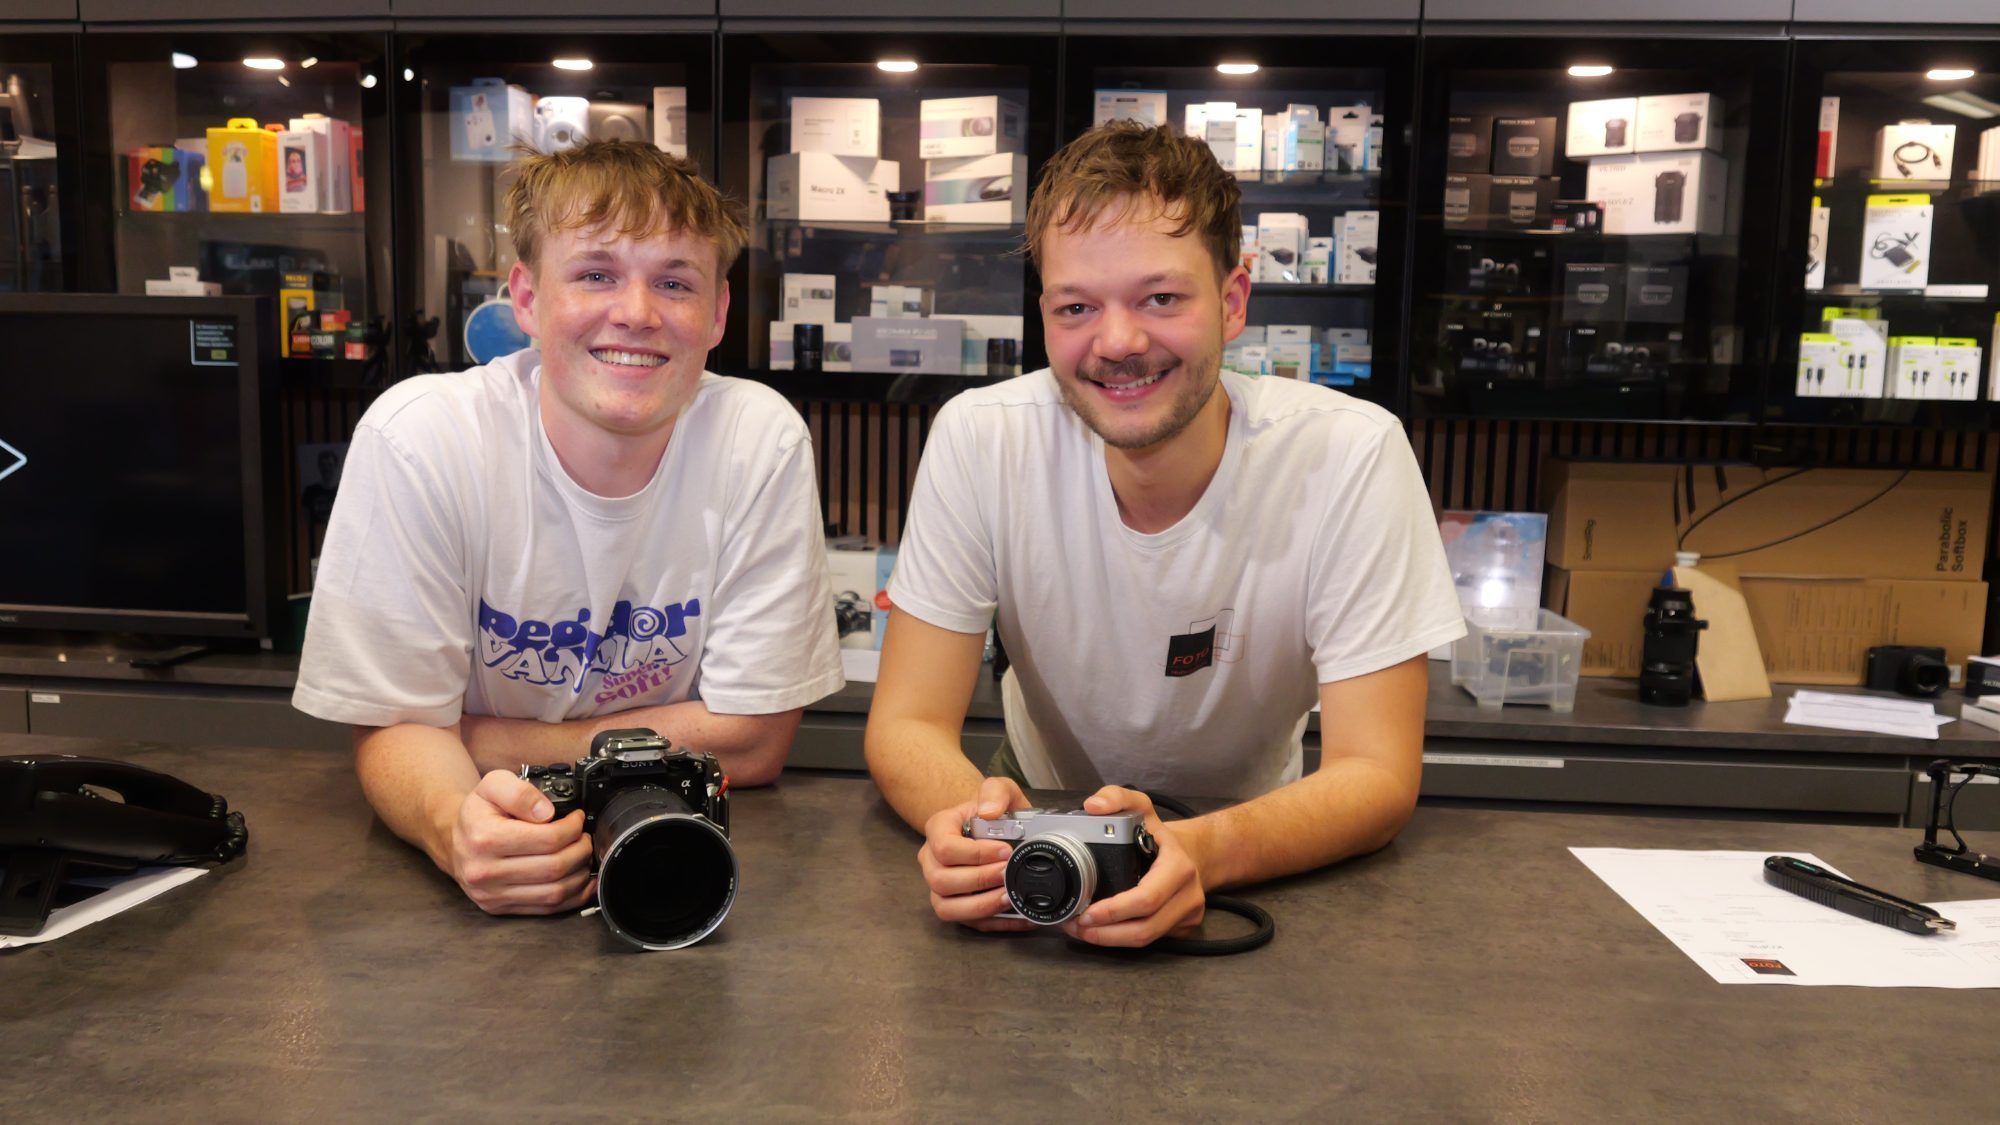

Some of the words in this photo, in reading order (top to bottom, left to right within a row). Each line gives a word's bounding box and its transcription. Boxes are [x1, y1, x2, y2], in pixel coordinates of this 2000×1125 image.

[811, 184, 834, 194] Macro
[1936, 507, 1953, 572] Parabolic
[1952, 520, 1968, 572] Softbox
